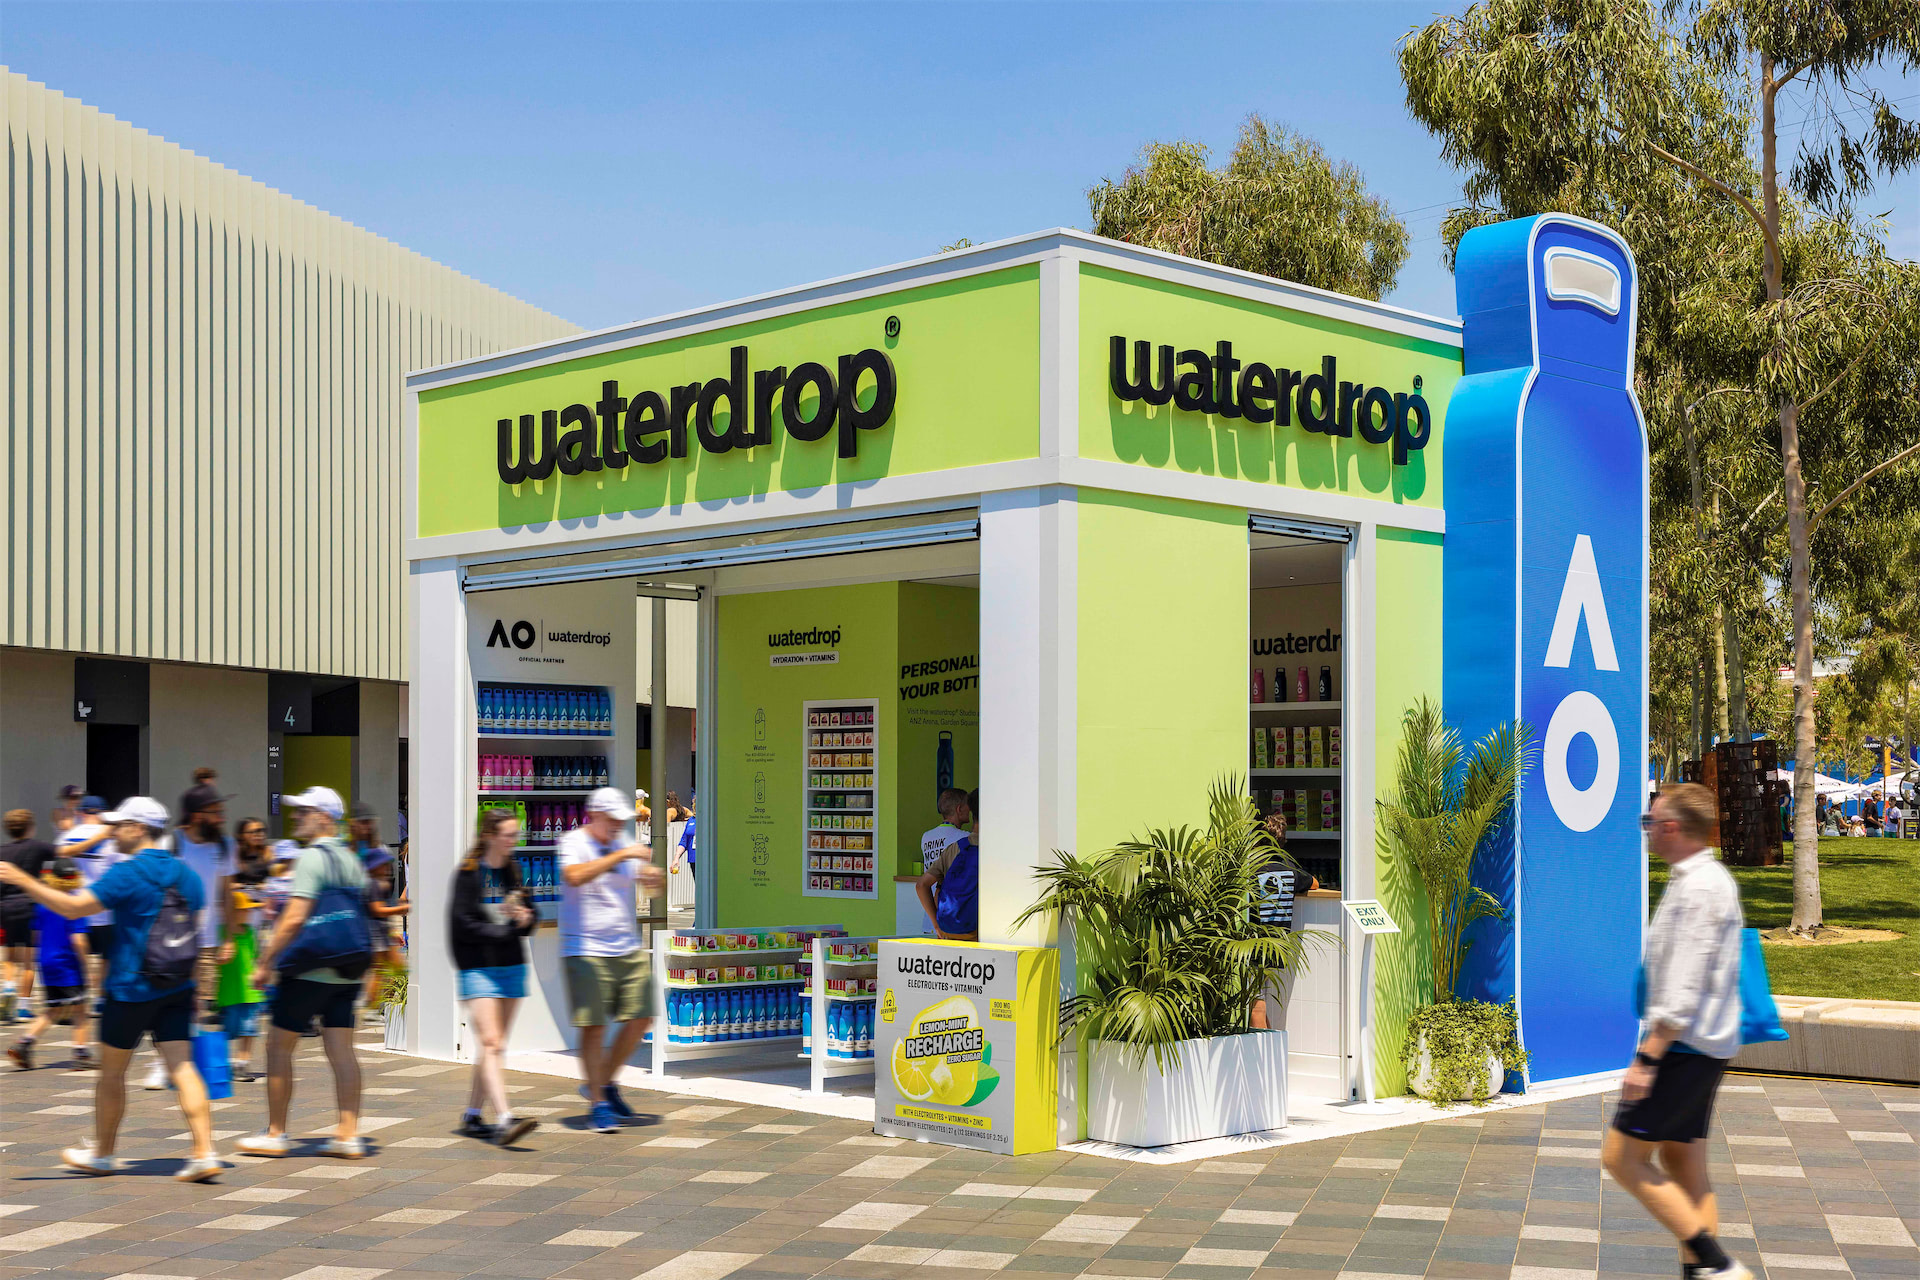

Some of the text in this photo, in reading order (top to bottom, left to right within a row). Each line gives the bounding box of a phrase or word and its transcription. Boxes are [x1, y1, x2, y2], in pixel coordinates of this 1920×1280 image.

[1253, 628, 1342, 656] waterdr
[772, 655, 804, 664] HYDRATION
[809, 653, 836, 662] VITAMINS
[900, 681, 940, 701] YOUR
[284, 706, 296, 727] 4
[924, 838, 946, 851] DRINK
[1355, 907, 1378, 916] EXIT
[1360, 917, 1385, 926] ONLY
[907, 979, 949, 991] ELECTROLYTES
[954, 983, 983, 994] VITAMINS
[885, 999, 892, 1007] 12
[920, 1017, 968, 1034] LEMON-MINT
[906, 1029, 982, 1059] RECHARGE
[947, 1052, 981, 1064] ZERO SUGAR
[902, 1108, 914, 1116] WITH
[914, 1110, 944, 1121] ELECTROLYTES
[948, 1114, 969, 1125] VITAMINS
[973, 1118, 984, 1127] ZINC
[881, 1116, 893, 1125] DRINK
[893, 1118, 906, 1127] CUBES
[906, 1121, 917, 1129] WITH
[917, 1122, 946, 1133] ELECTROLYTES
[964, 1129, 986, 1139] SERVINGS
